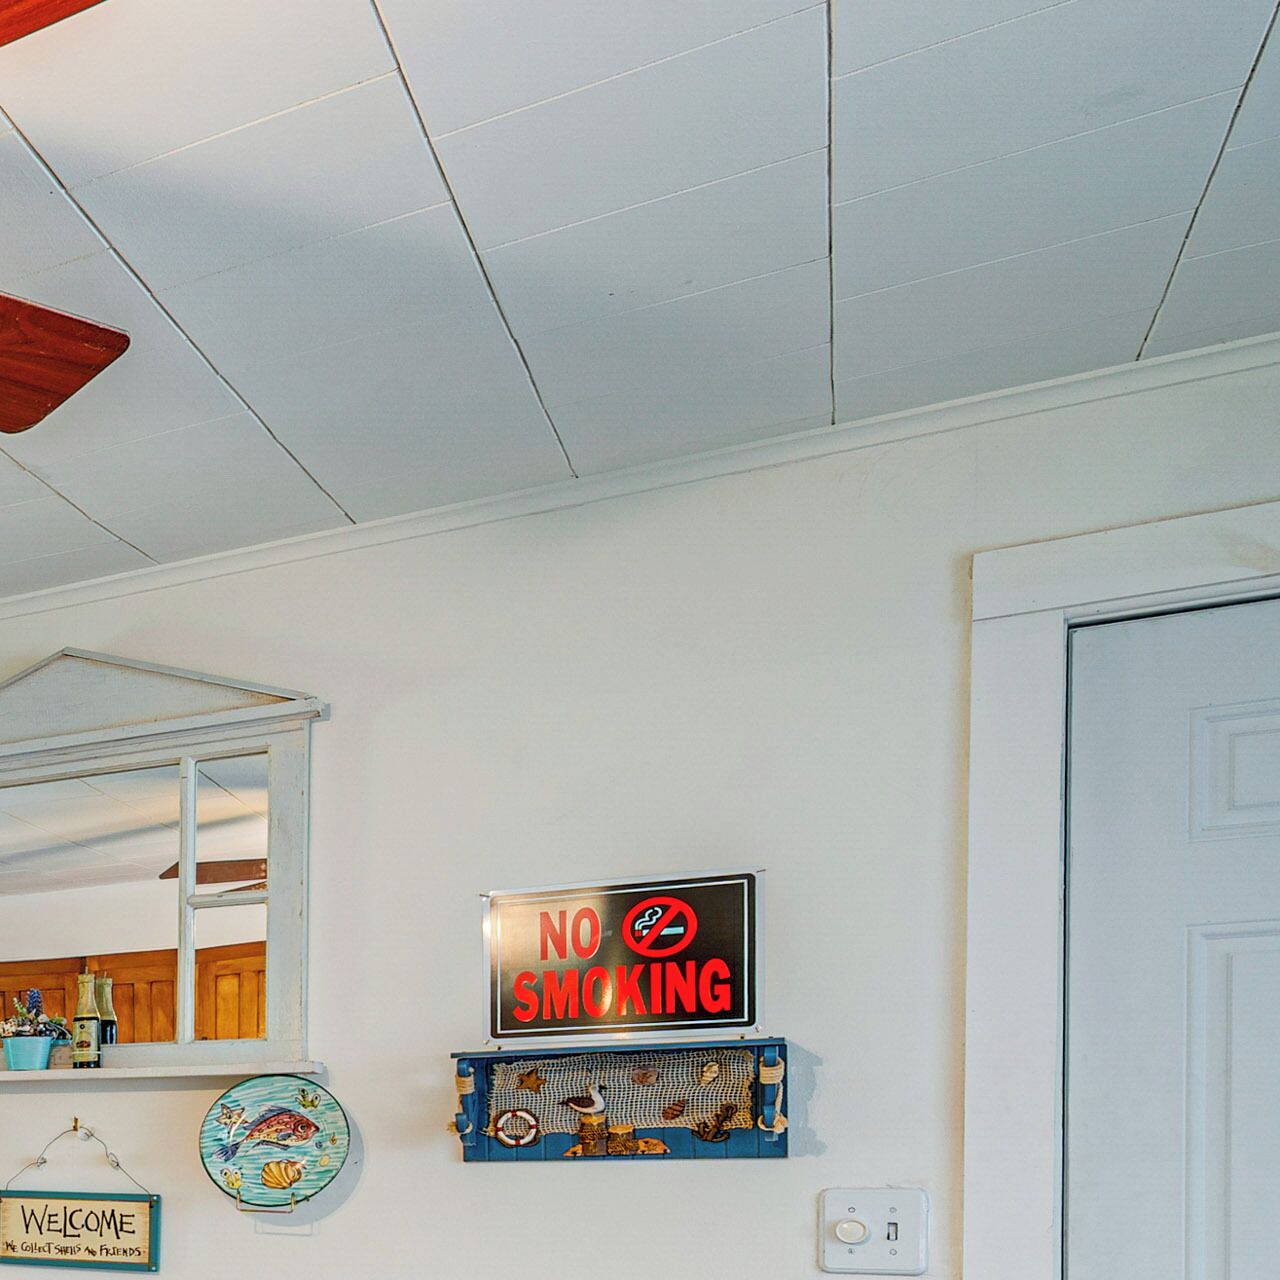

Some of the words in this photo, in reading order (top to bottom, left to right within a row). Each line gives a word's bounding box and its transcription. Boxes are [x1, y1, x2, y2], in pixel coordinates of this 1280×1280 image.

[540, 907, 601, 961] NO
[513, 958, 731, 1023] SMOKING
[21, 1204, 136, 1239] WELCOME
